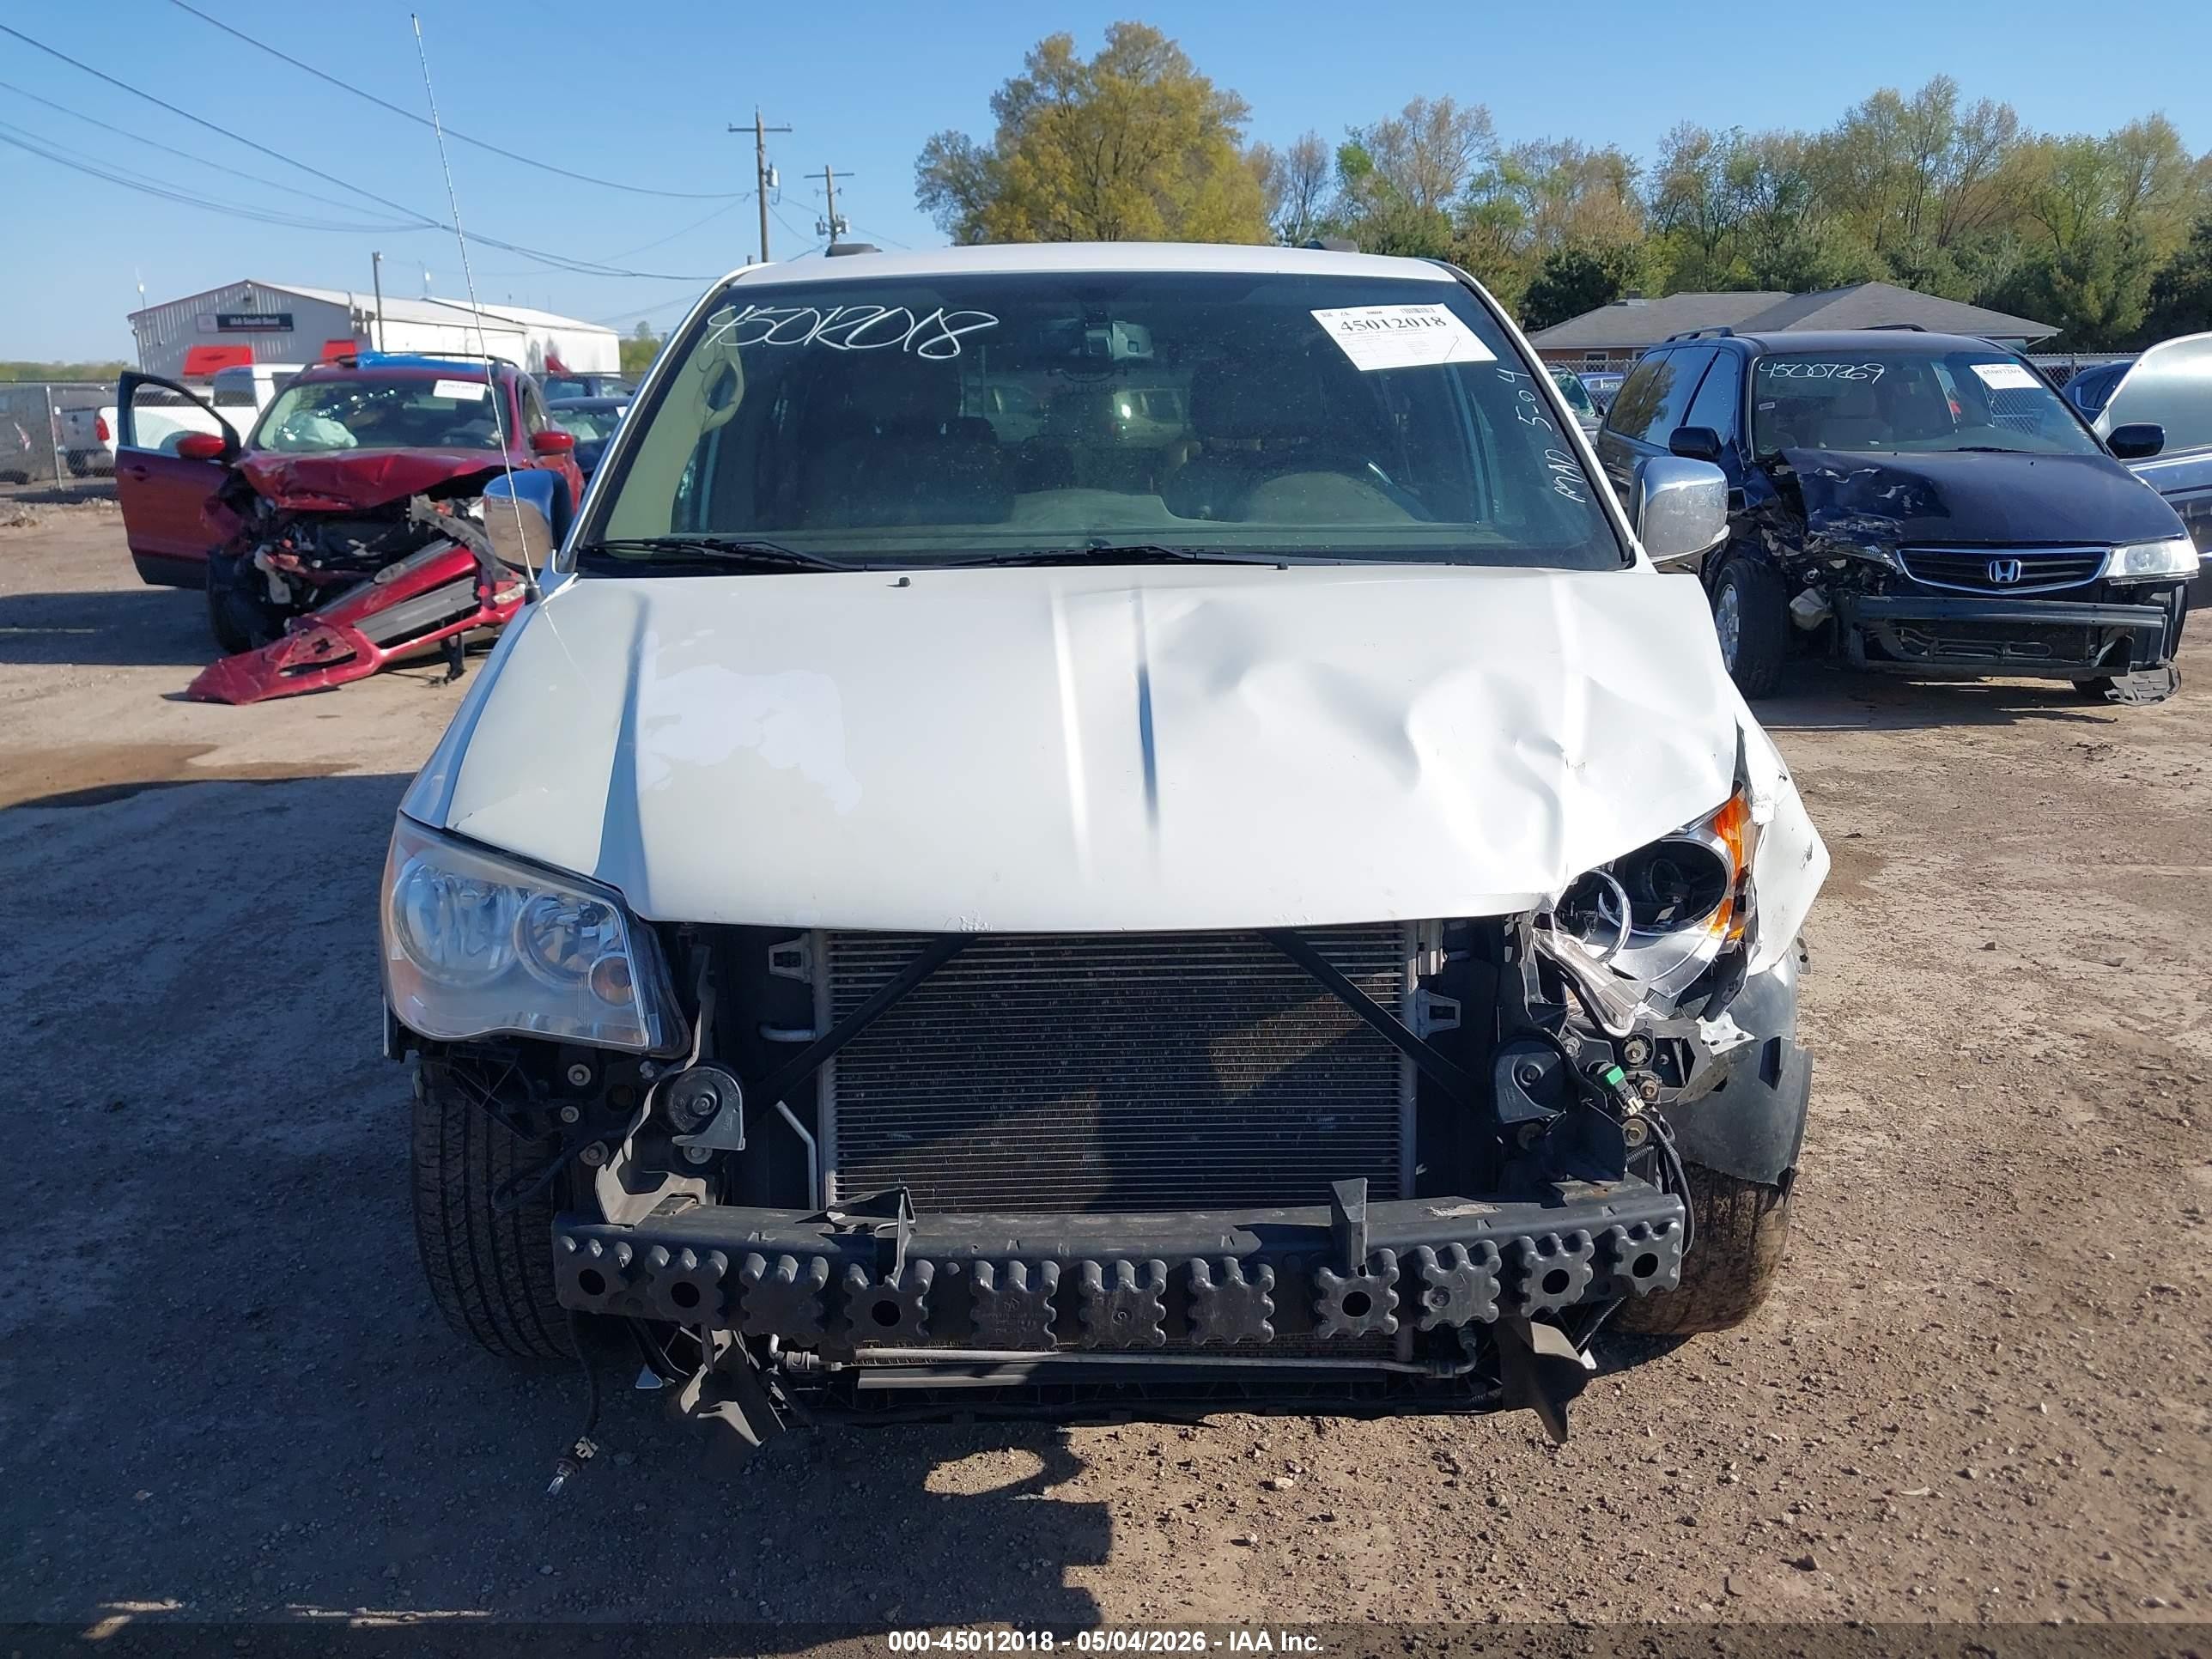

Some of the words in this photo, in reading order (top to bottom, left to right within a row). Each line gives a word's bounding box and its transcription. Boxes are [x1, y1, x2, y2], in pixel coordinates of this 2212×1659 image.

[704, 305, 1000, 359] 45012018
[1340, 316, 1447, 331] 45012018
[1759, 362, 1885, 384] 45007269
